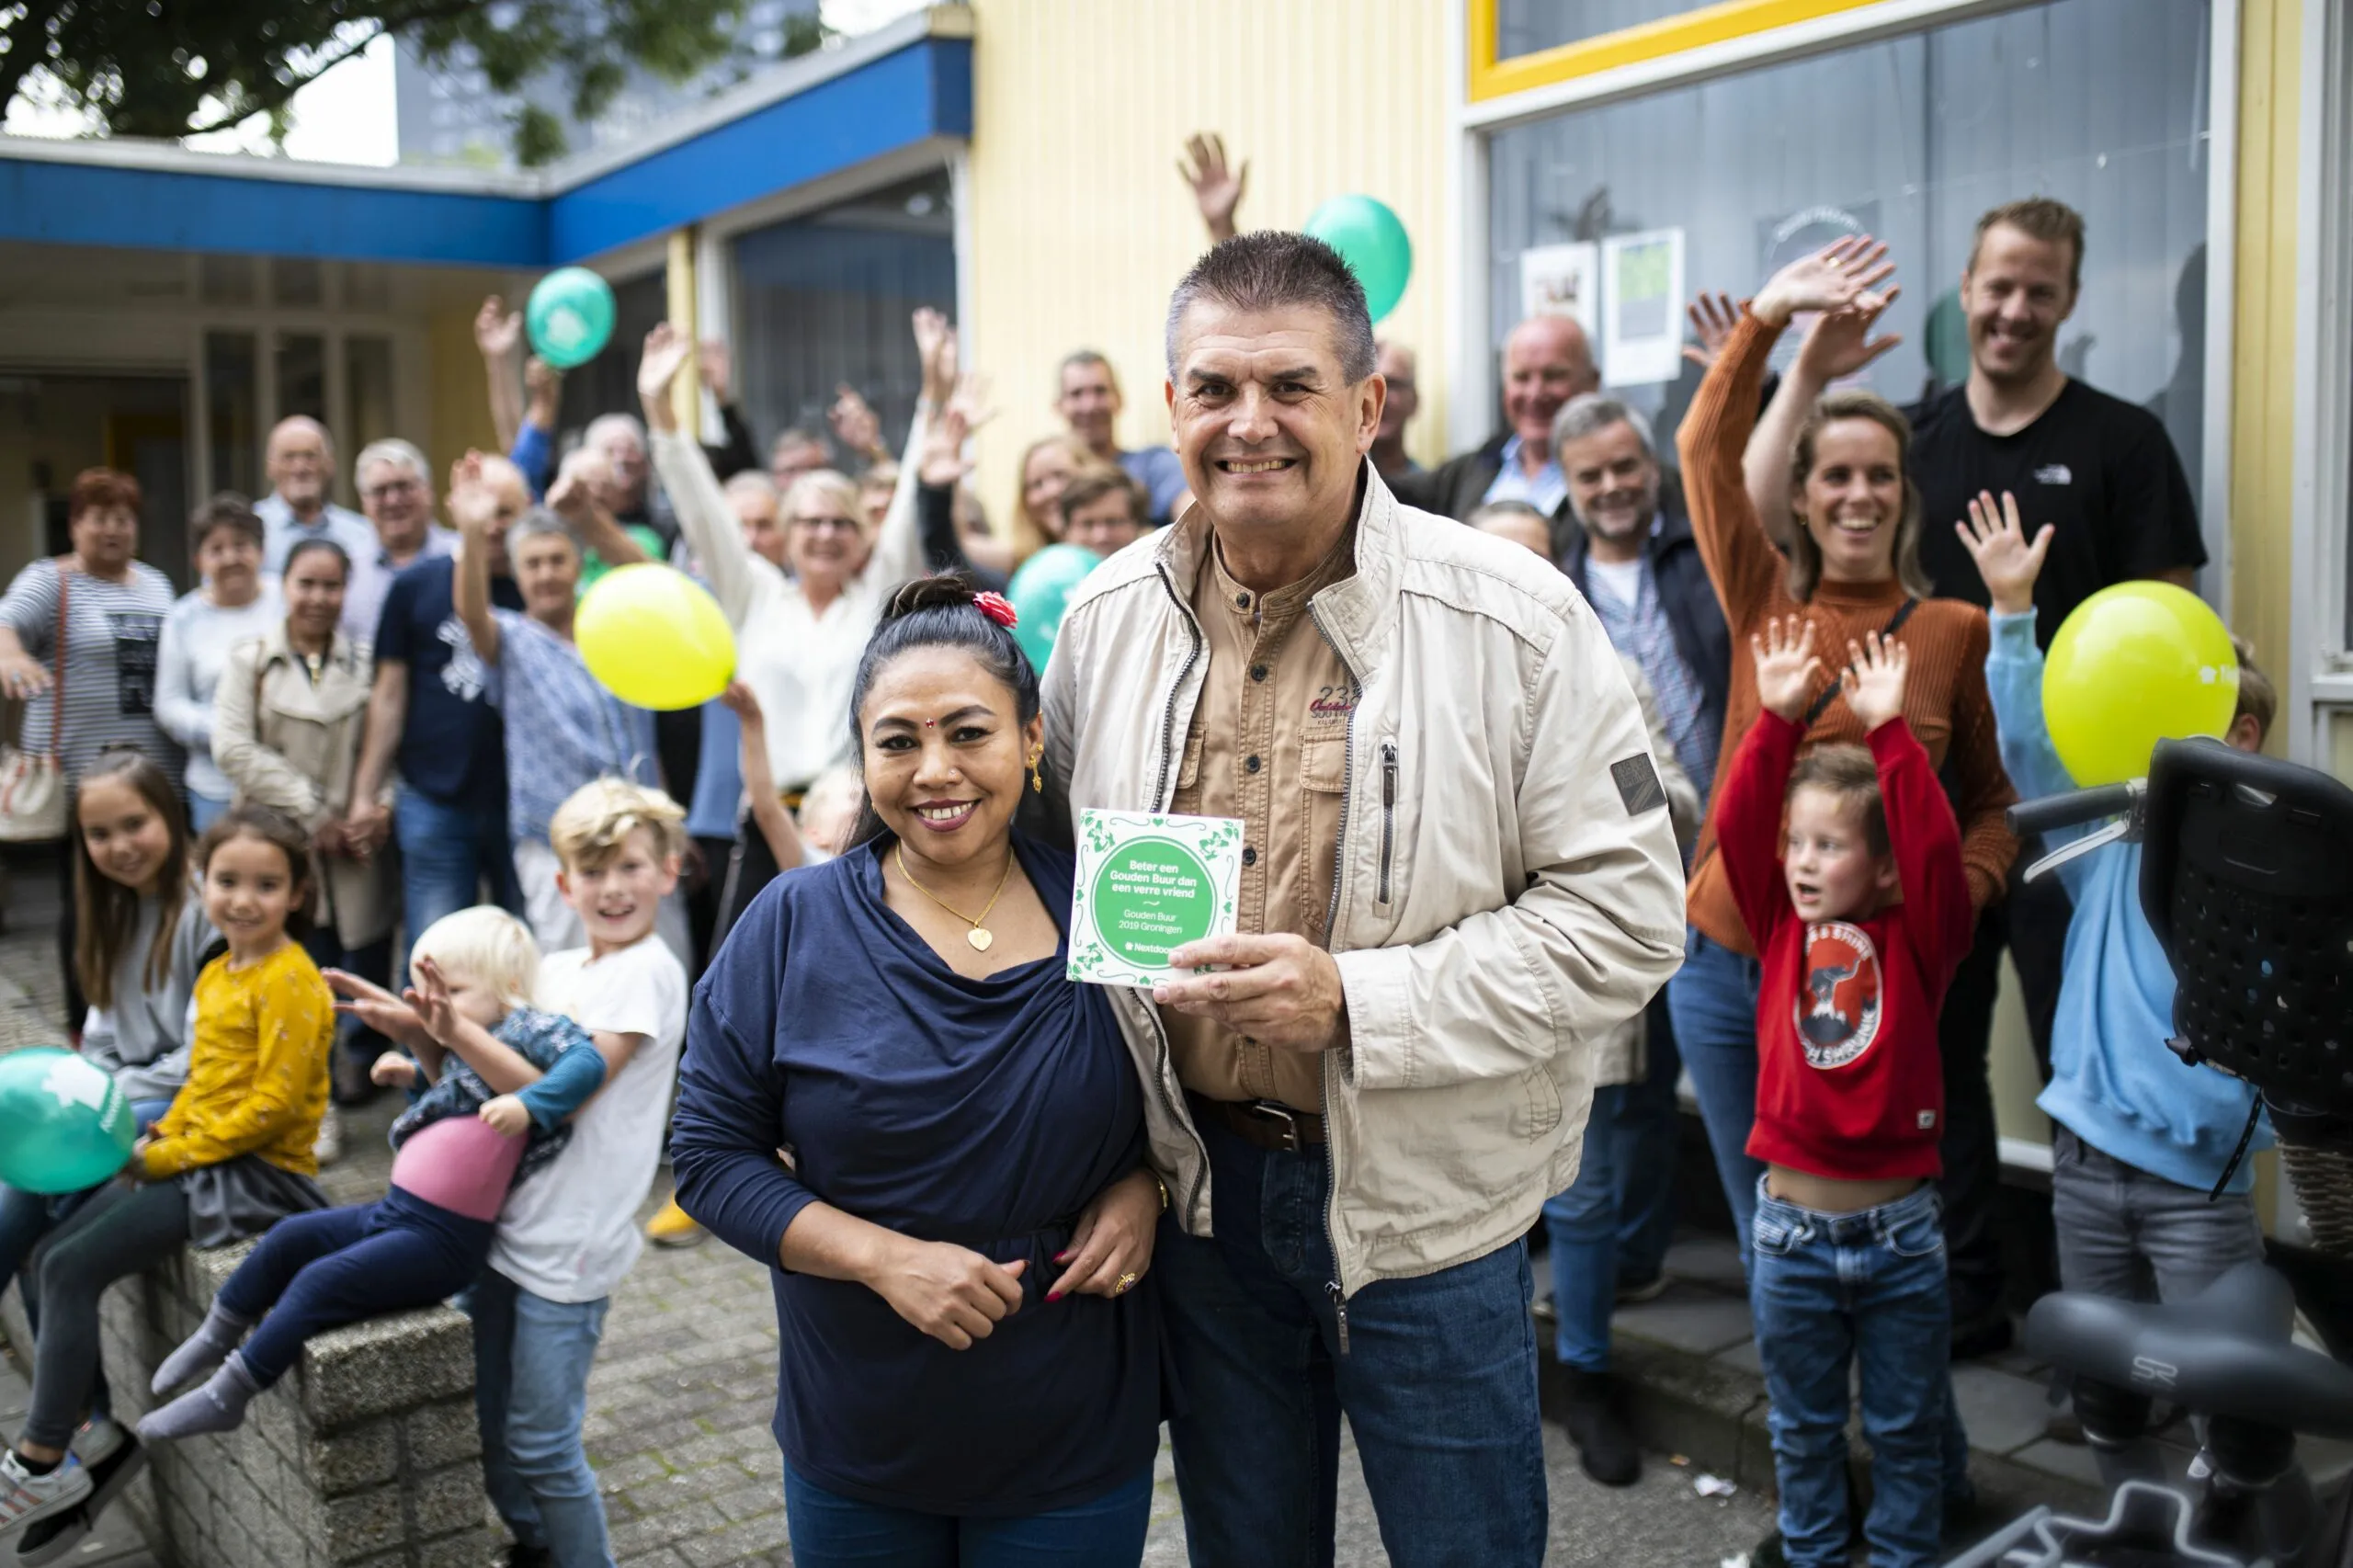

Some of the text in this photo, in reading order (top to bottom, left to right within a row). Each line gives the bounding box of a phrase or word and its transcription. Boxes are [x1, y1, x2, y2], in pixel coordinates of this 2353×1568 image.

[1130, 859, 1178, 873] Beter een
[1109, 869, 1197, 887] Gouden Buur dan
[1111, 883, 1195, 898] een verre vriend
[1123, 908, 1176, 922] Gouden Buur
[1118, 919, 1182, 934] 2019 Groningen
[1134, 942, 1170, 954] Nextdoo
